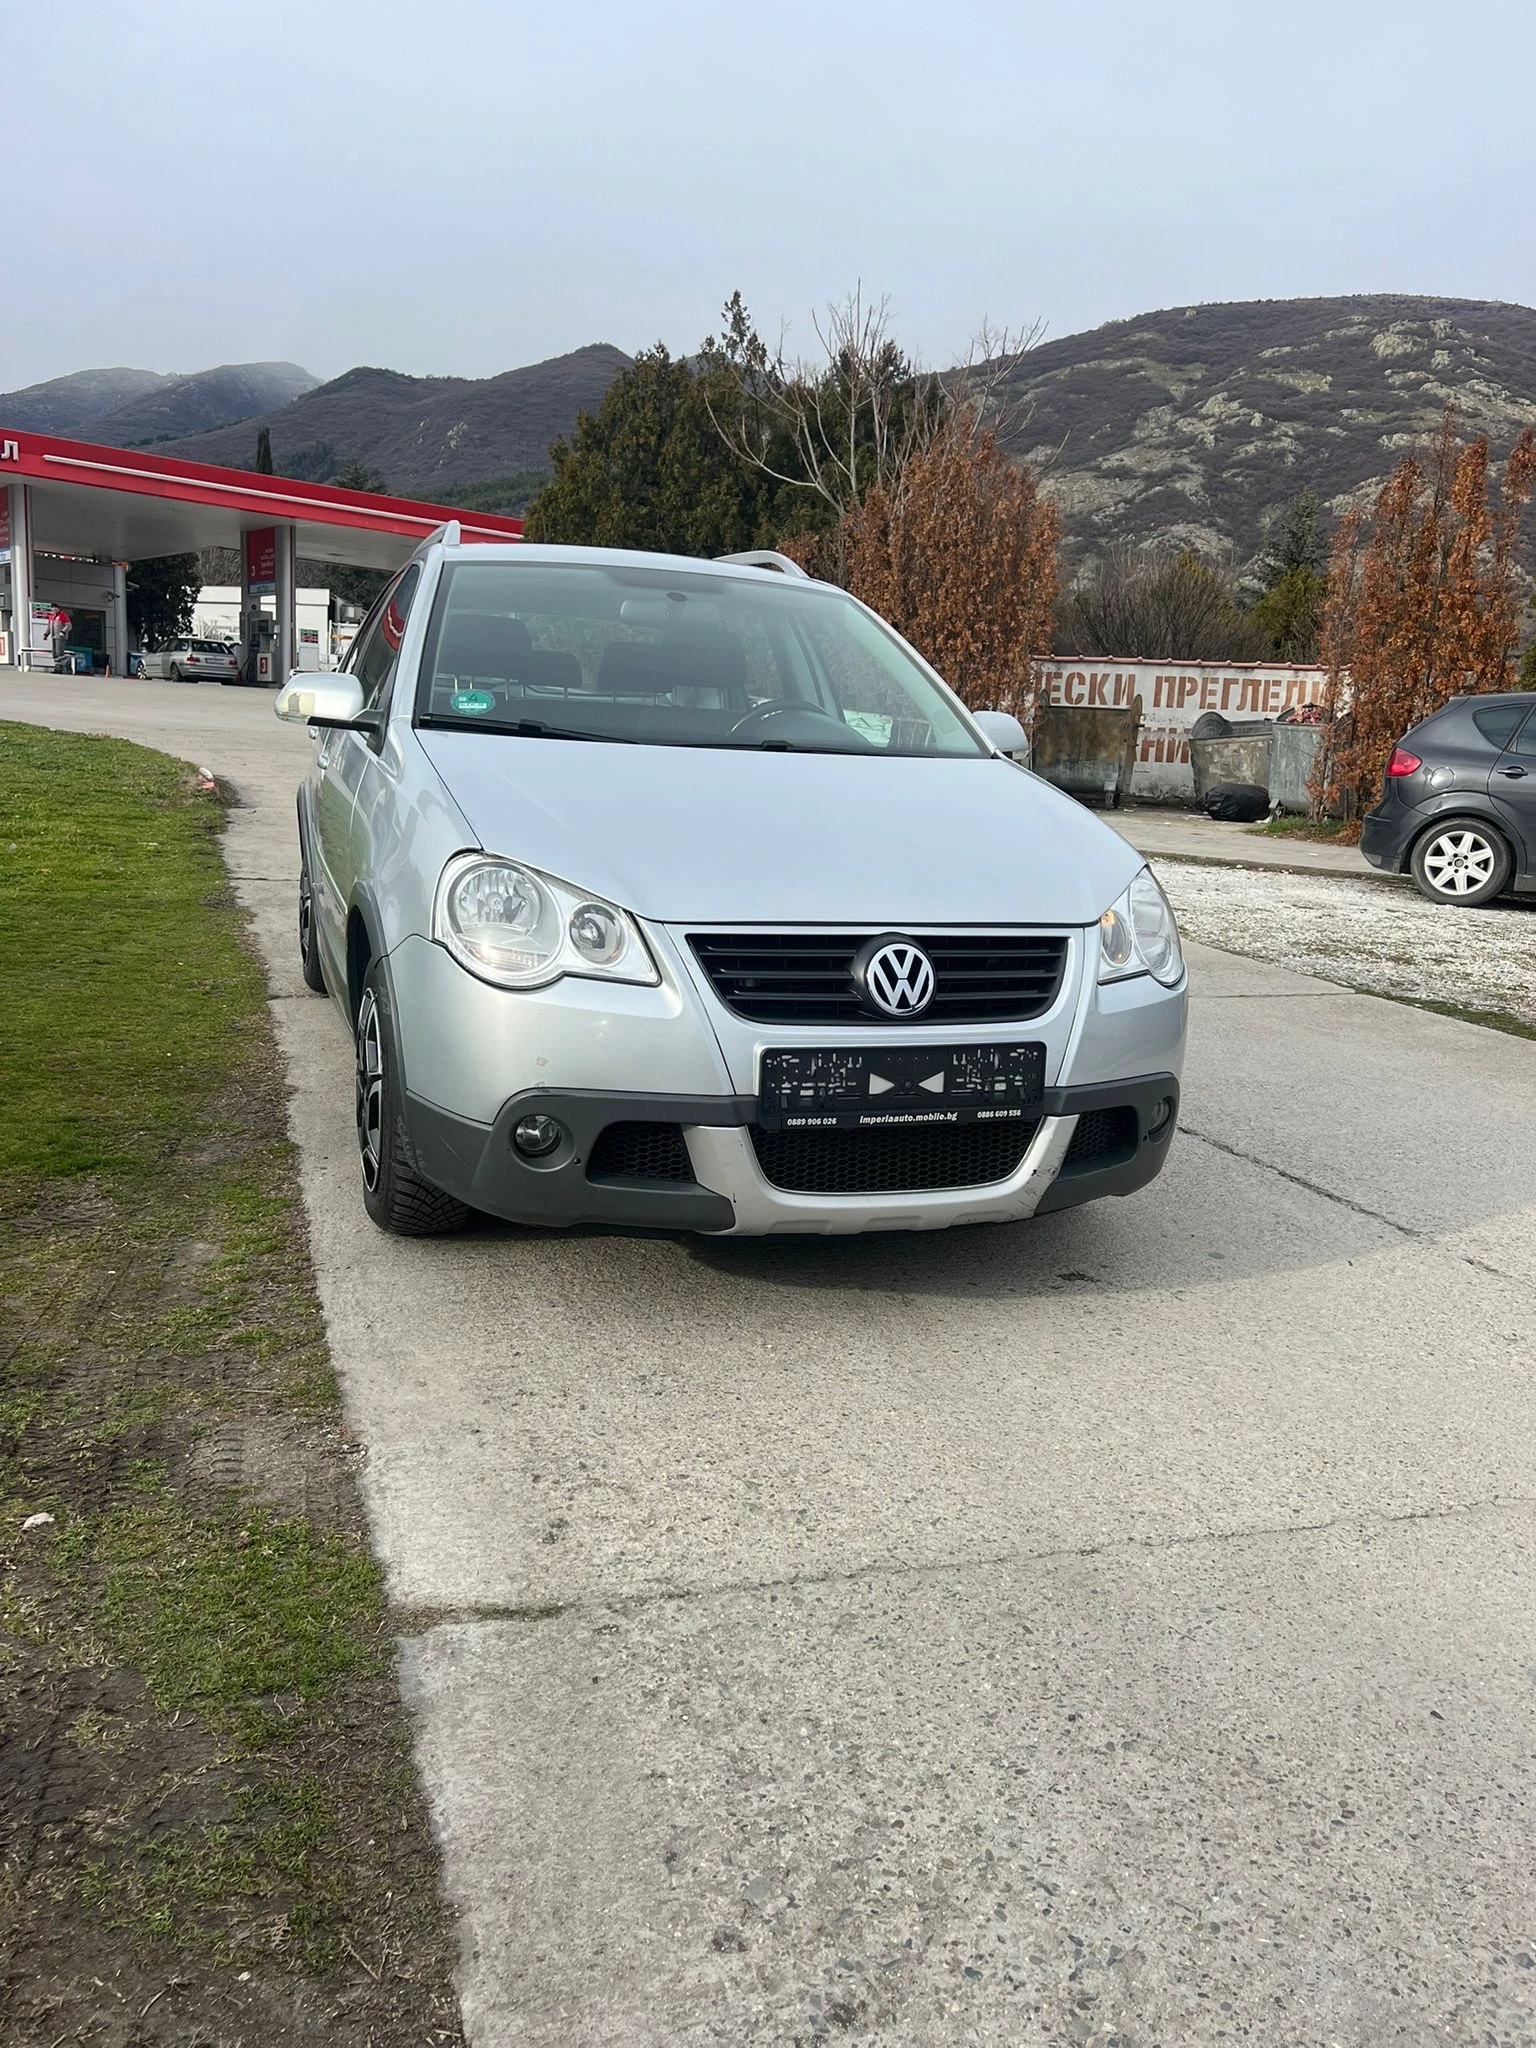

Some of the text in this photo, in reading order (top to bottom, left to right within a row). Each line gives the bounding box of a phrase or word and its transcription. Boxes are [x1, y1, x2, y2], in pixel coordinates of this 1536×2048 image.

[261, 658, 268, 674] 3
[977, 1110, 994, 1119] 0886
[1008, 1109, 1021, 1117] 556
[787, 1118, 806, 1126] 0889
[822, 1117, 837, 1125] 026
